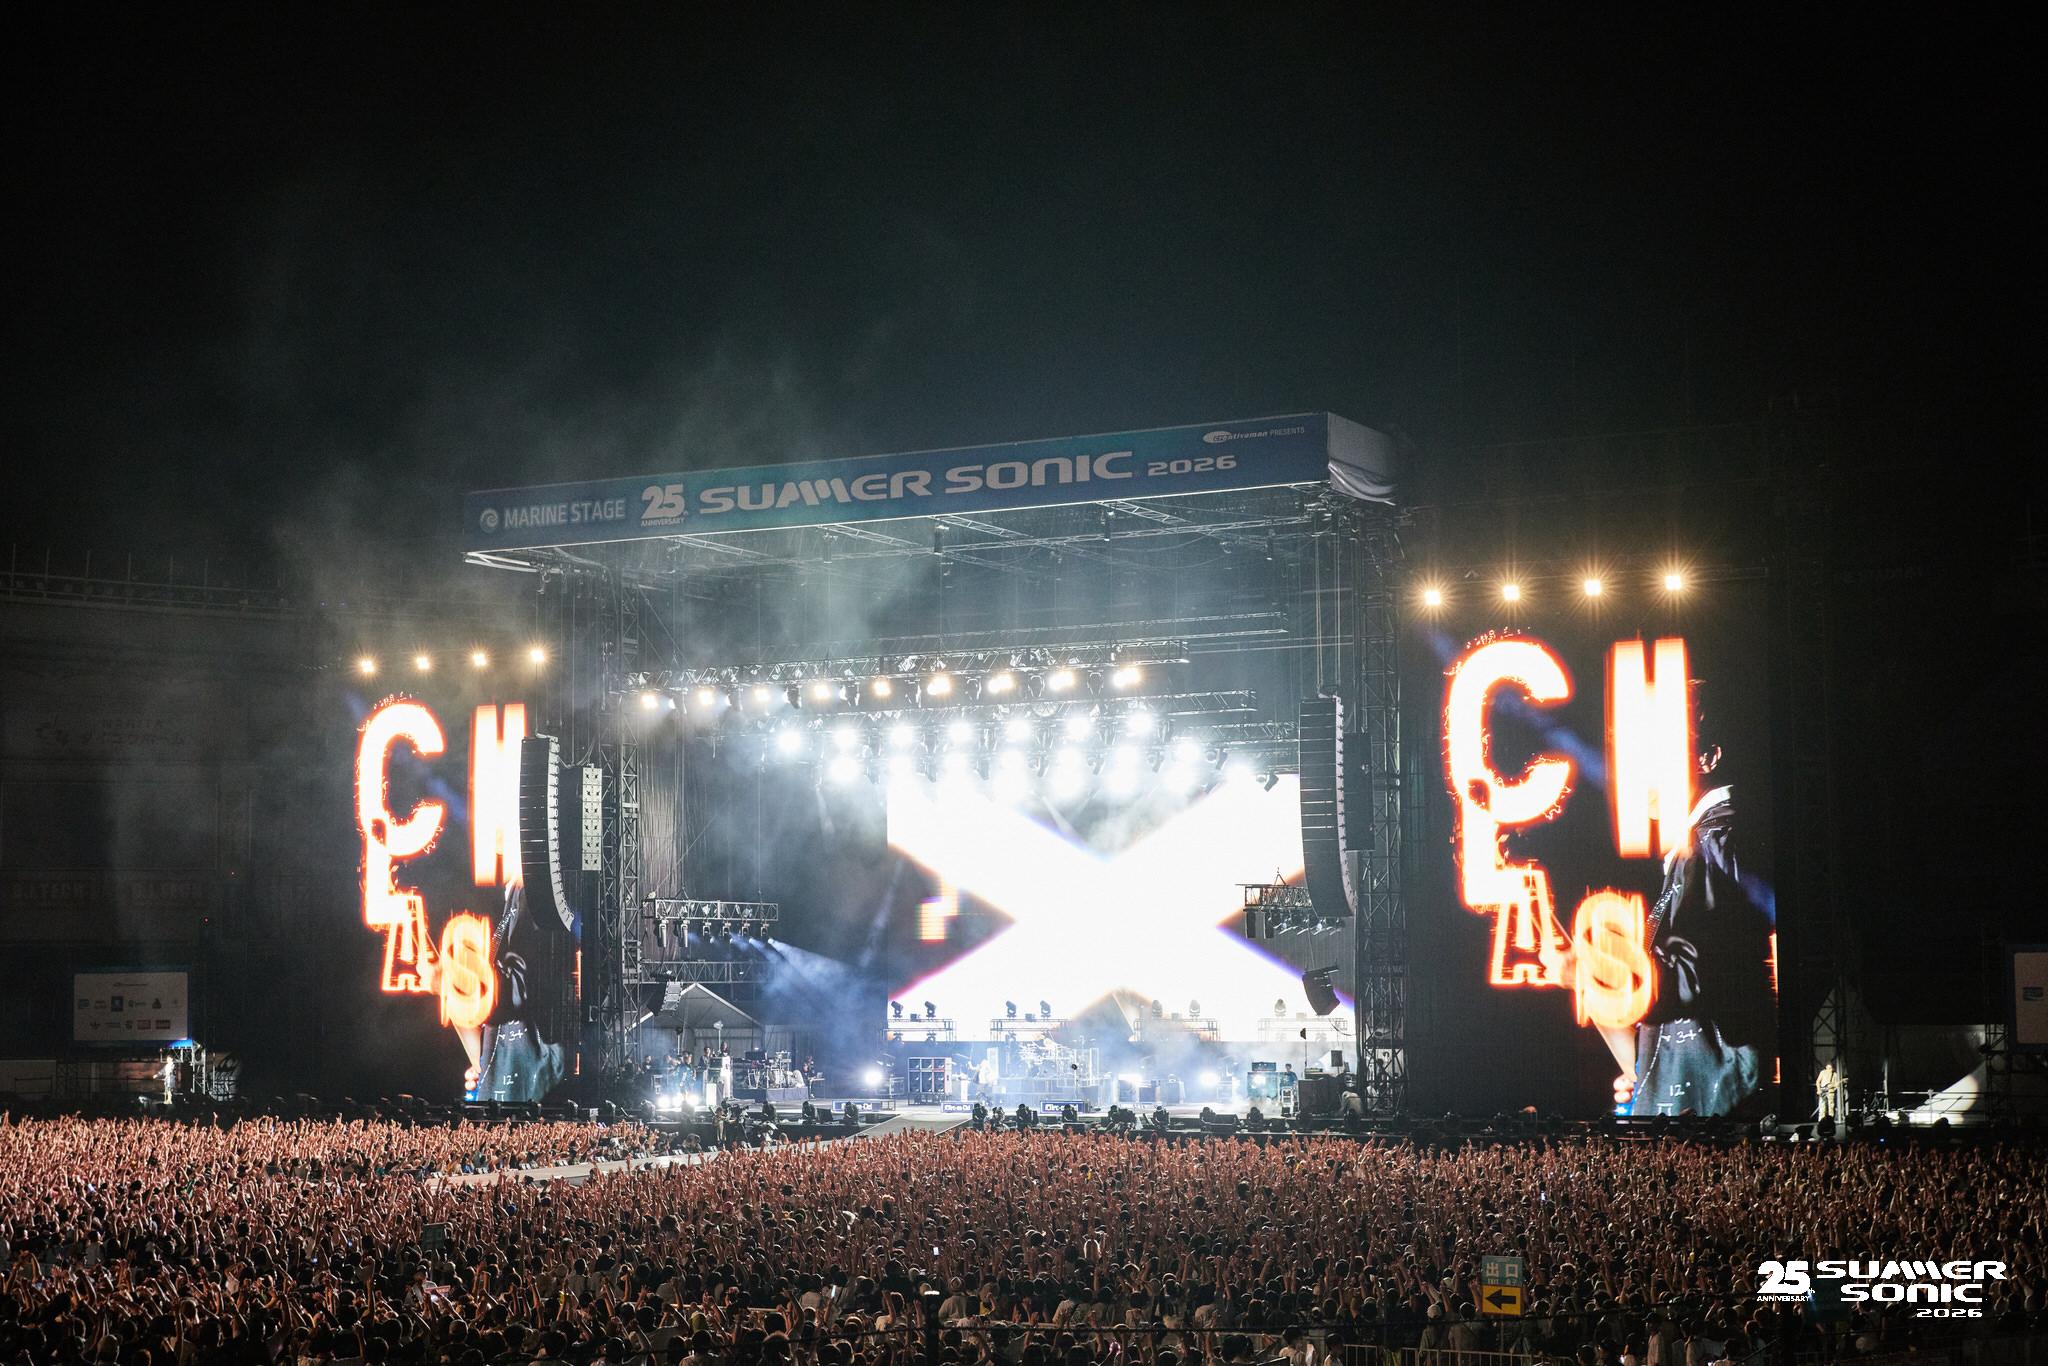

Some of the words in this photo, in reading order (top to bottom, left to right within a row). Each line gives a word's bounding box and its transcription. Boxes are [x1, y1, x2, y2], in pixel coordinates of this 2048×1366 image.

[1269, 426, 1305, 436] PRESENTS
[699, 470, 933, 514] SUMMER
[945, 451, 1133, 494] SONIC
[1147, 455, 1237, 476] 2026
[503, 505, 568, 528] MARINE
[570, 499, 626, 522] STAGE
[640, 517, 685, 528] ANNIVERSARY
[1486, 1262, 1519, 1278] 出口
